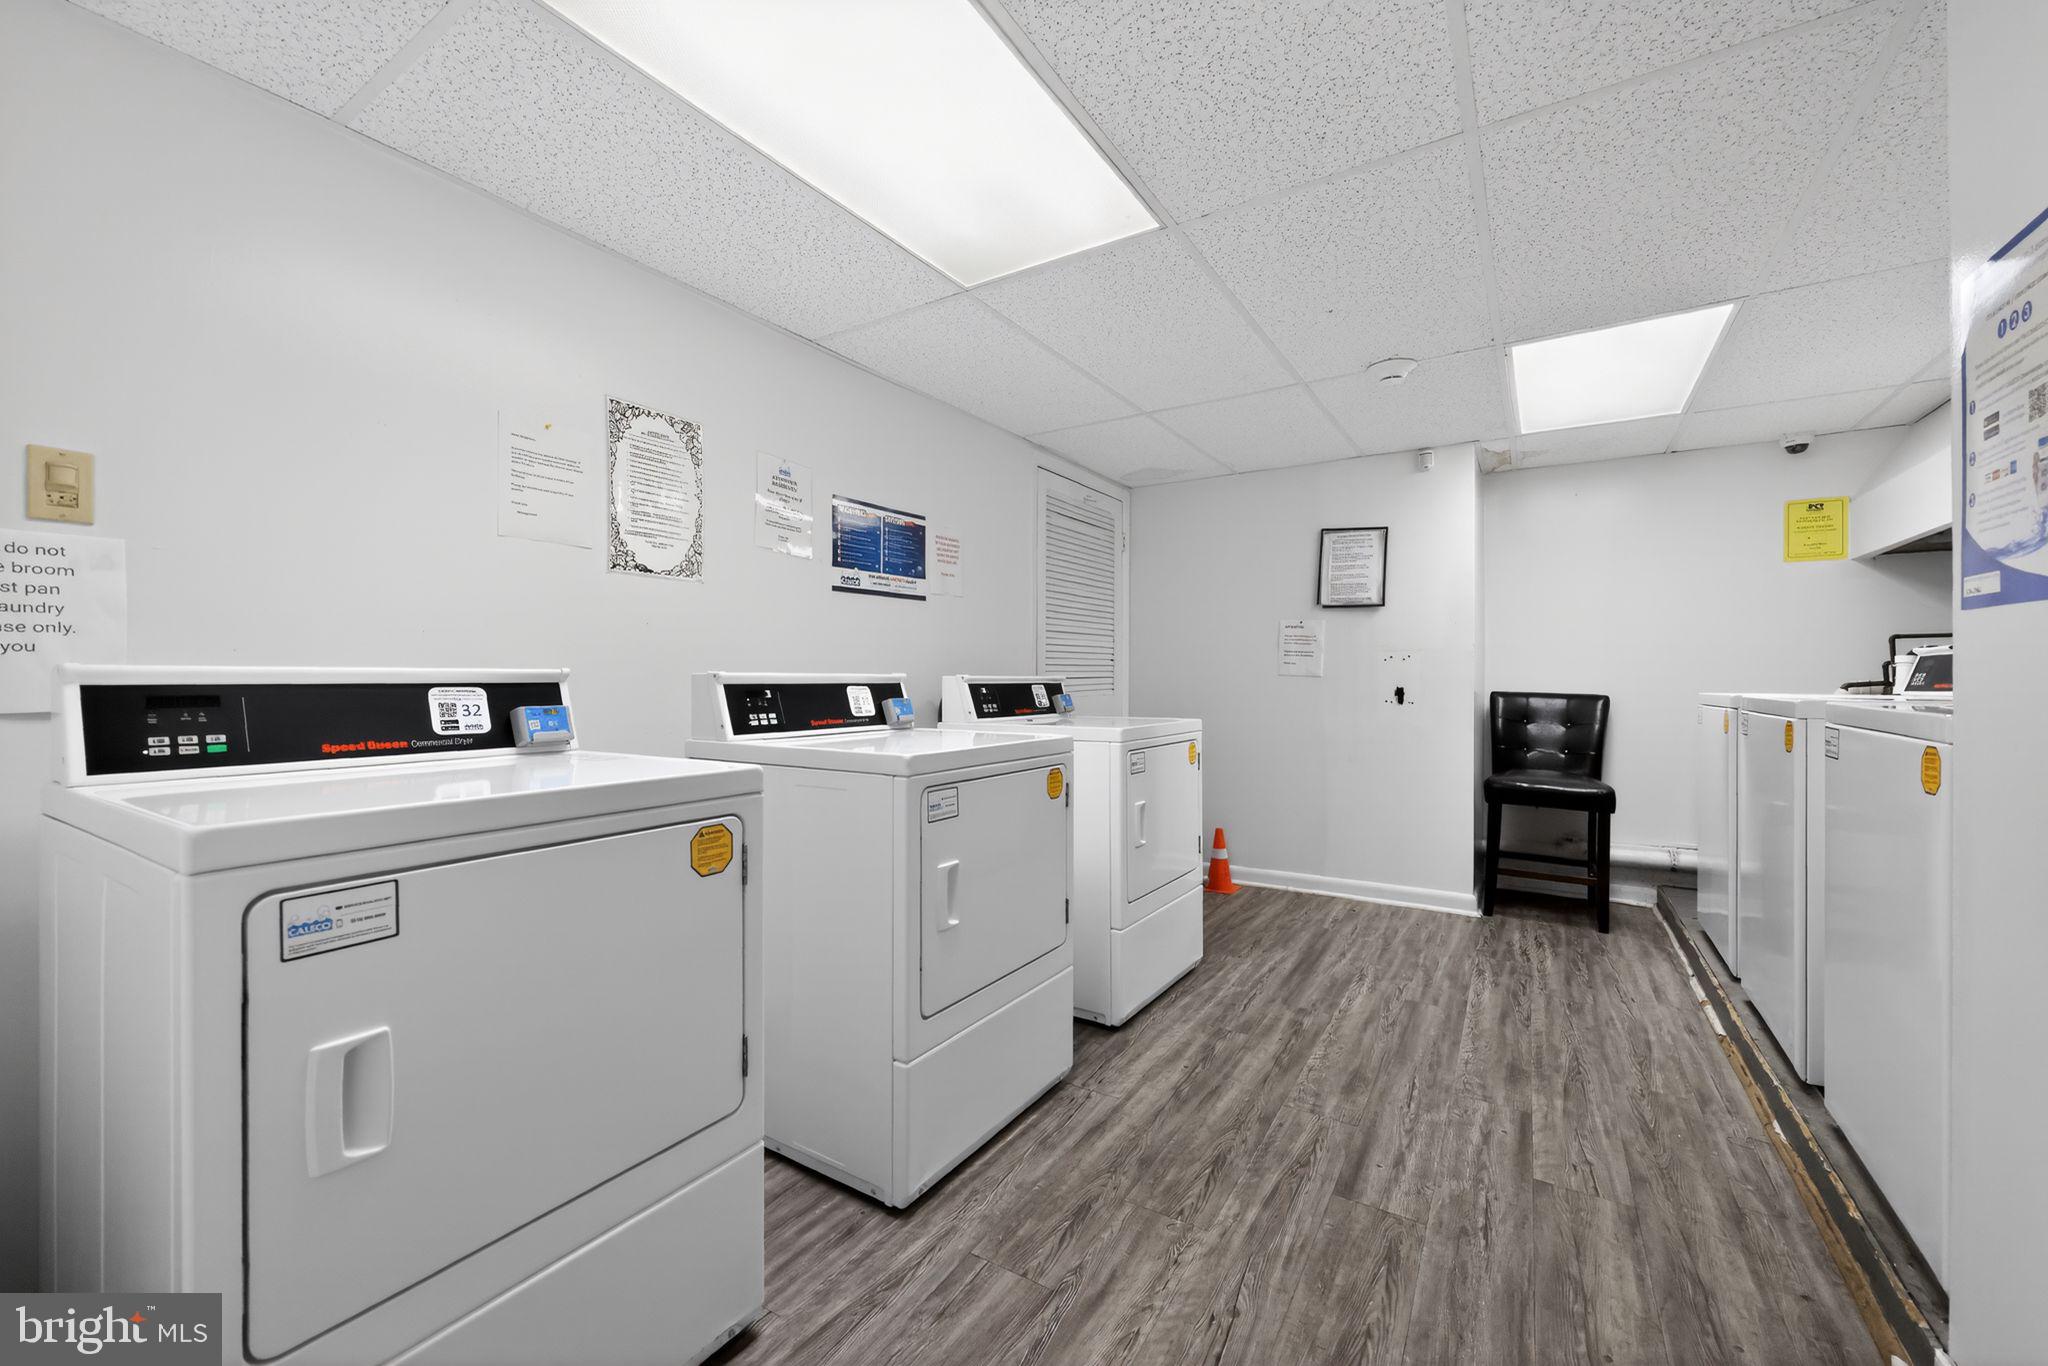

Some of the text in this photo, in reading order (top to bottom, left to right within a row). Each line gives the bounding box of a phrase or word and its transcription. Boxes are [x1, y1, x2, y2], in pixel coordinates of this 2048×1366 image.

[4, 542, 66, 557] do not
[11, 562, 75, 576] broom
[25, 584, 61, 596] pan
[0, 602, 65, 617] aundry
[0, 621, 76, 636] se only.
[0, 643, 36, 656] you
[461, 704, 482, 717] 32
[321, 741, 366, 754] Speed
[367, 740, 408, 750] Queen
